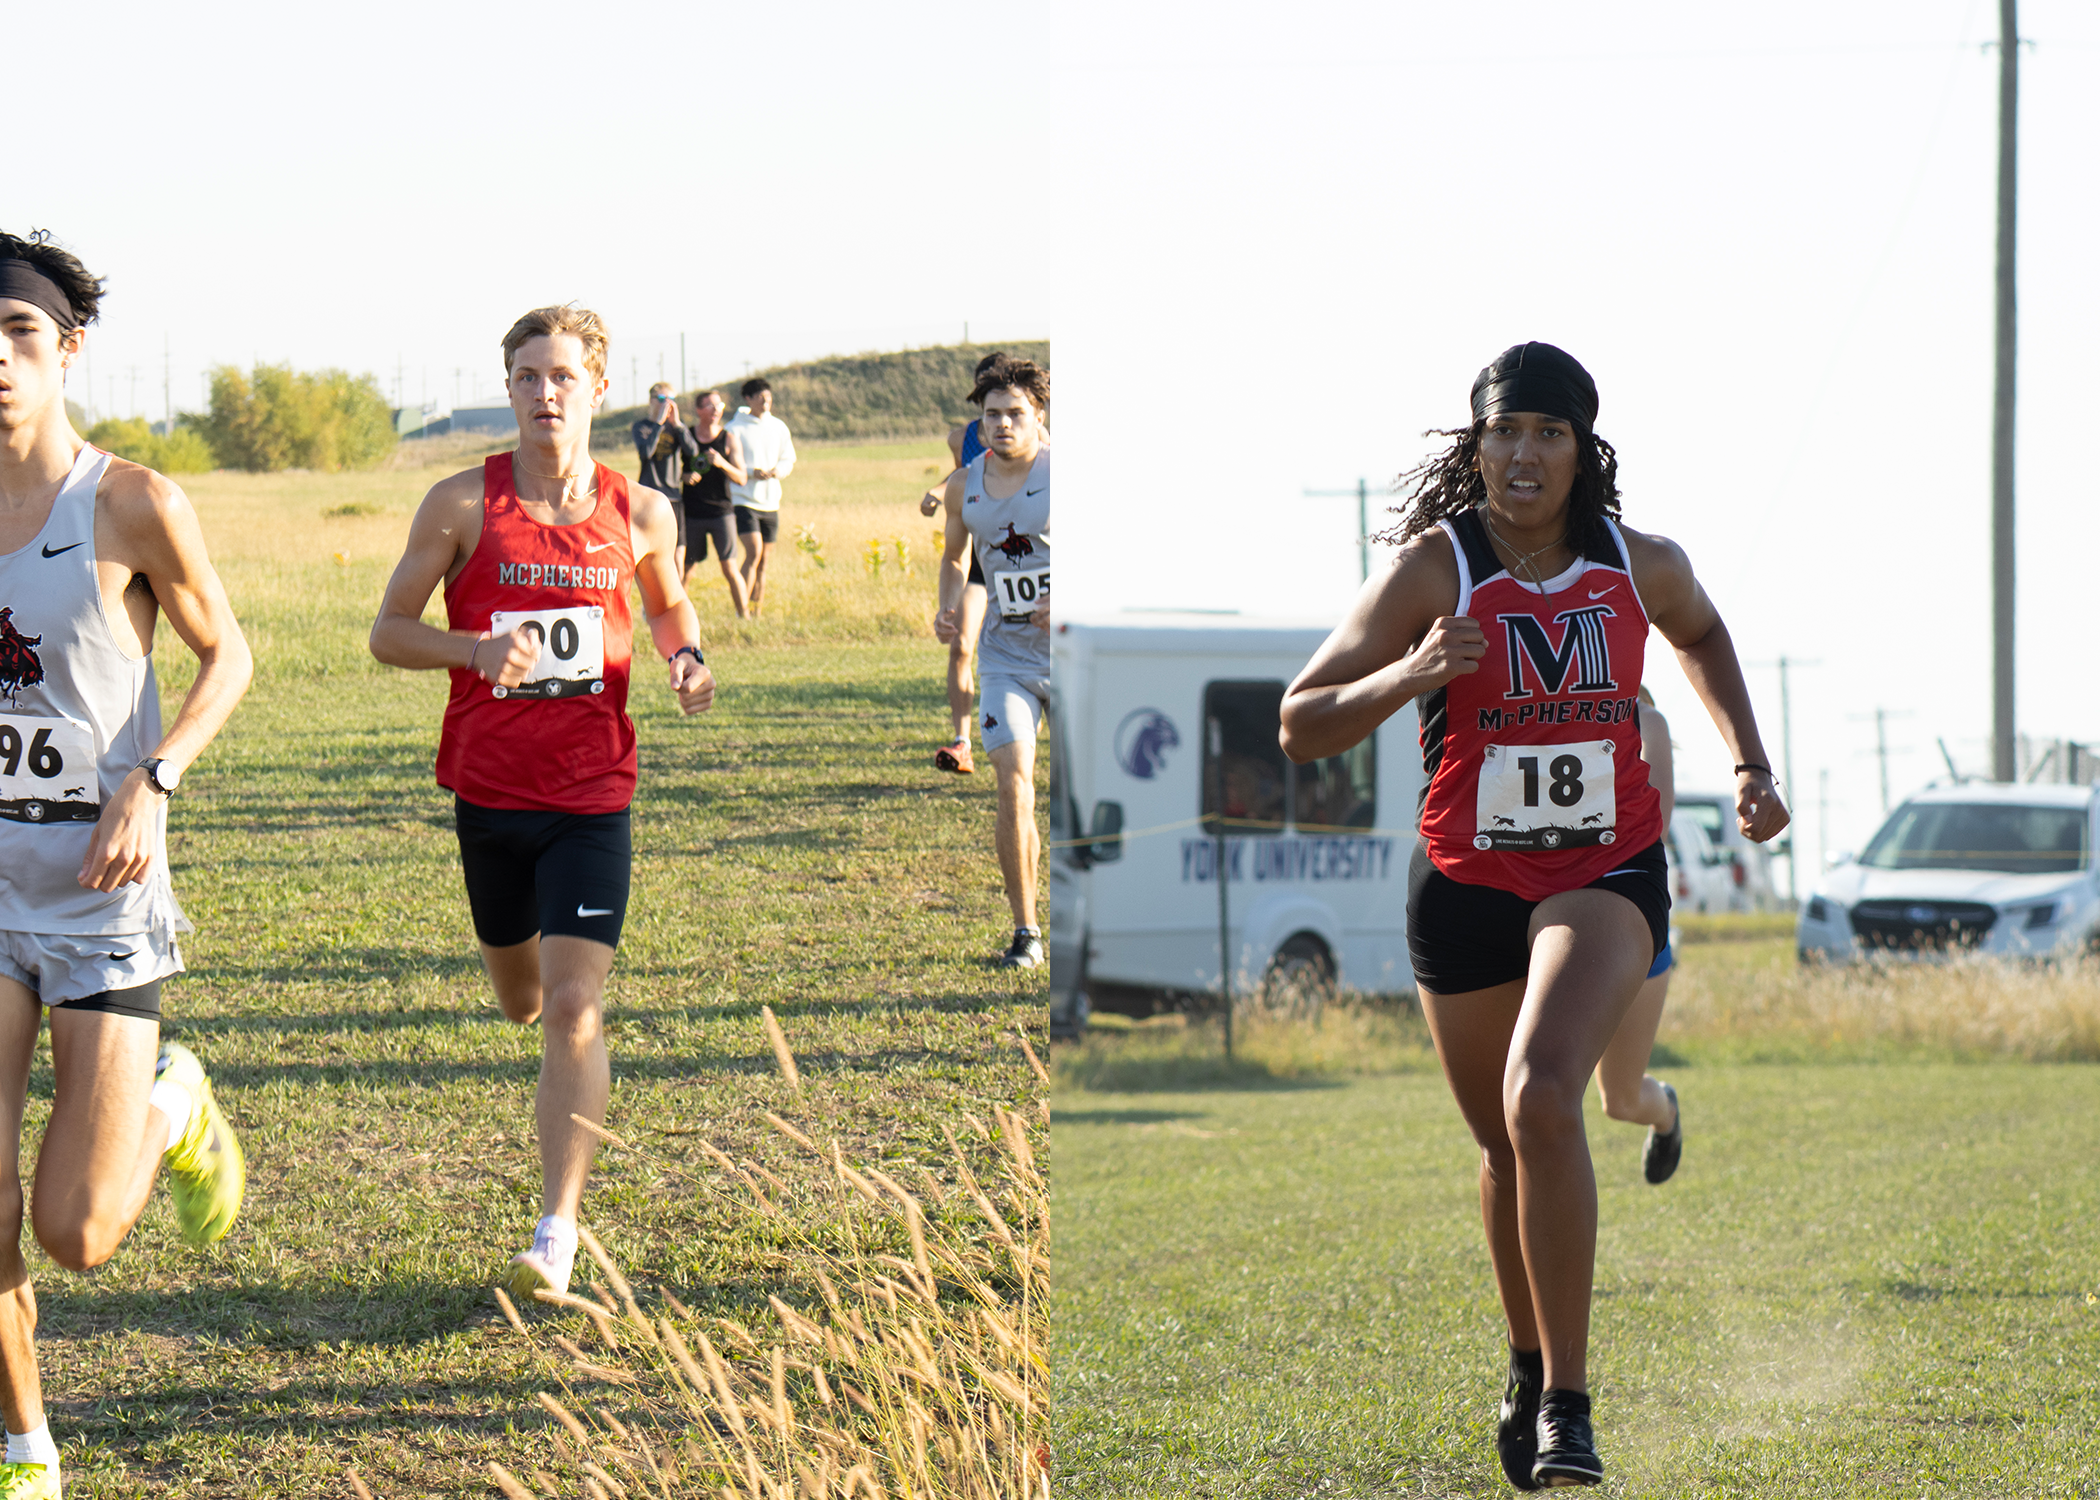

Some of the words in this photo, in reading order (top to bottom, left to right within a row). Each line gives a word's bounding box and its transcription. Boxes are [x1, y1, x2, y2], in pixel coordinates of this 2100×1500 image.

[498, 562, 619, 591] MCPHERSON
[1003, 572, 1050, 602] 105
[1497, 604, 1618, 700] M
[0, 724, 64, 779] 96
[1518, 754, 1585, 808] 18
[1253, 838, 1393, 883] UNIVERSITY
